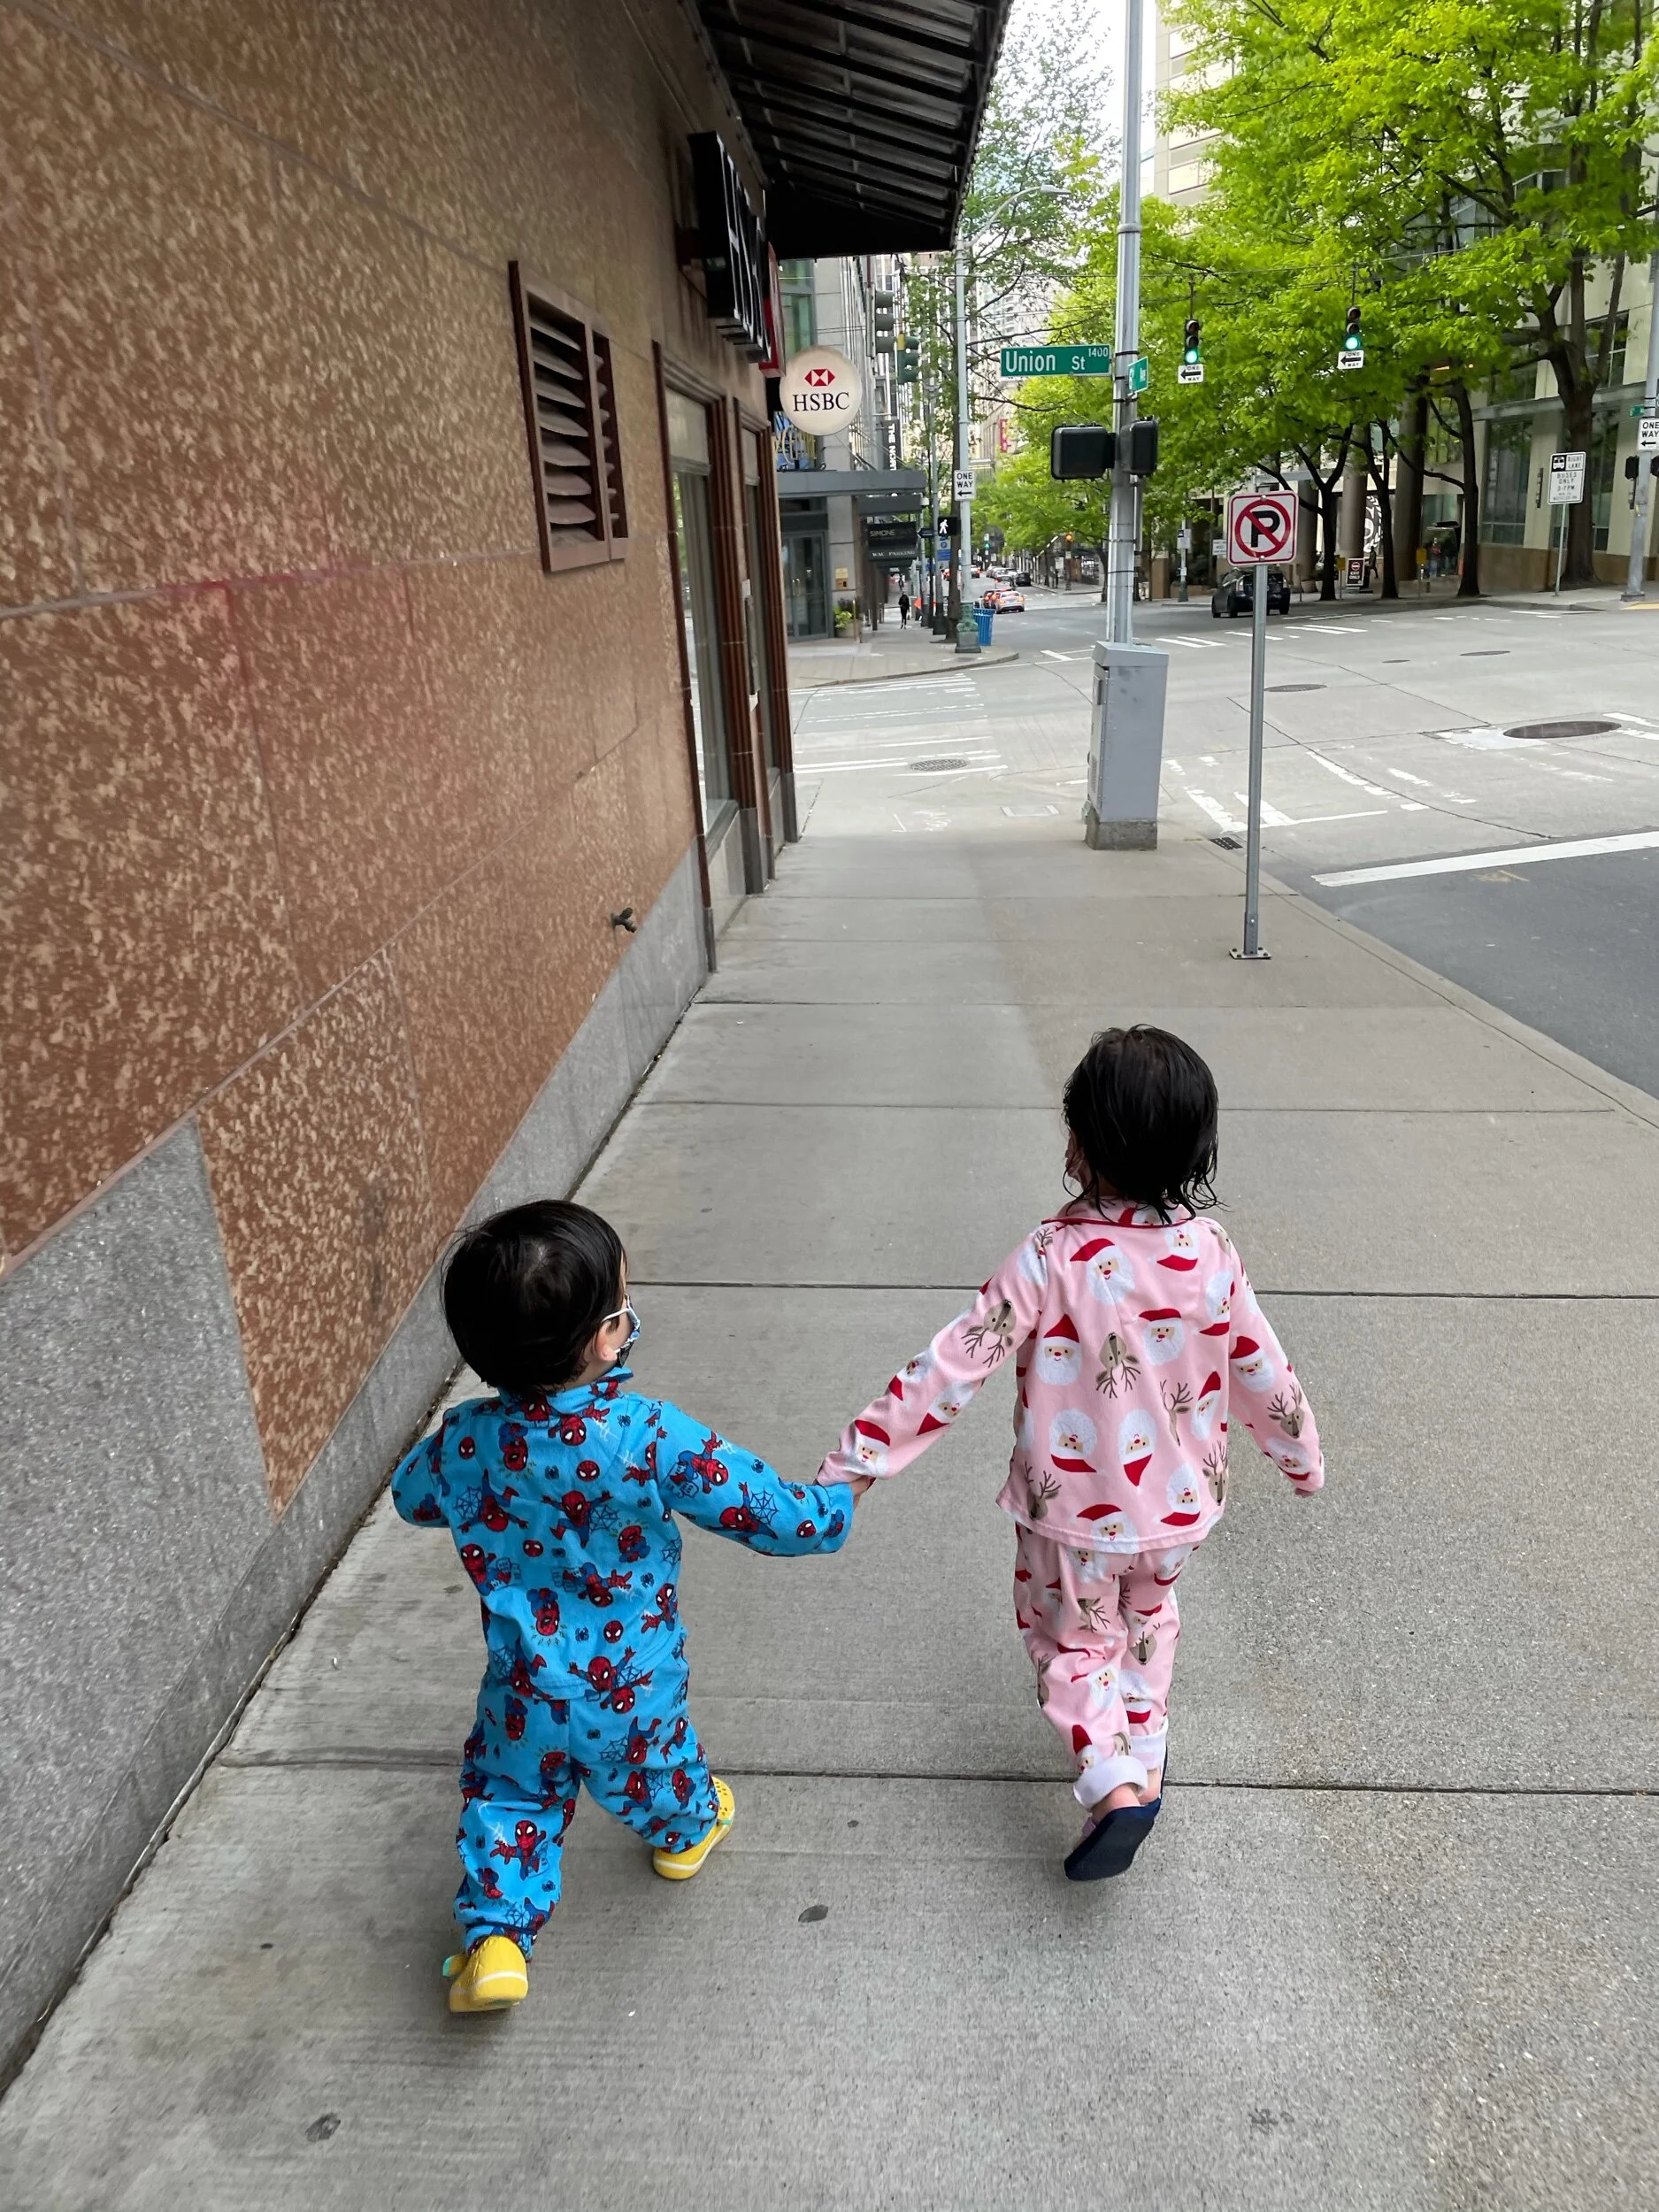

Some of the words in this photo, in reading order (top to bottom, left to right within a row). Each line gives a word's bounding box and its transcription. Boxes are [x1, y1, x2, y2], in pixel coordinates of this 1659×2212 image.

[1005, 350, 1056, 373] Union
[1071, 356, 1086, 370] St
[1088, 348, 1109, 357] 1400
[792, 392, 850, 411] HSBC
